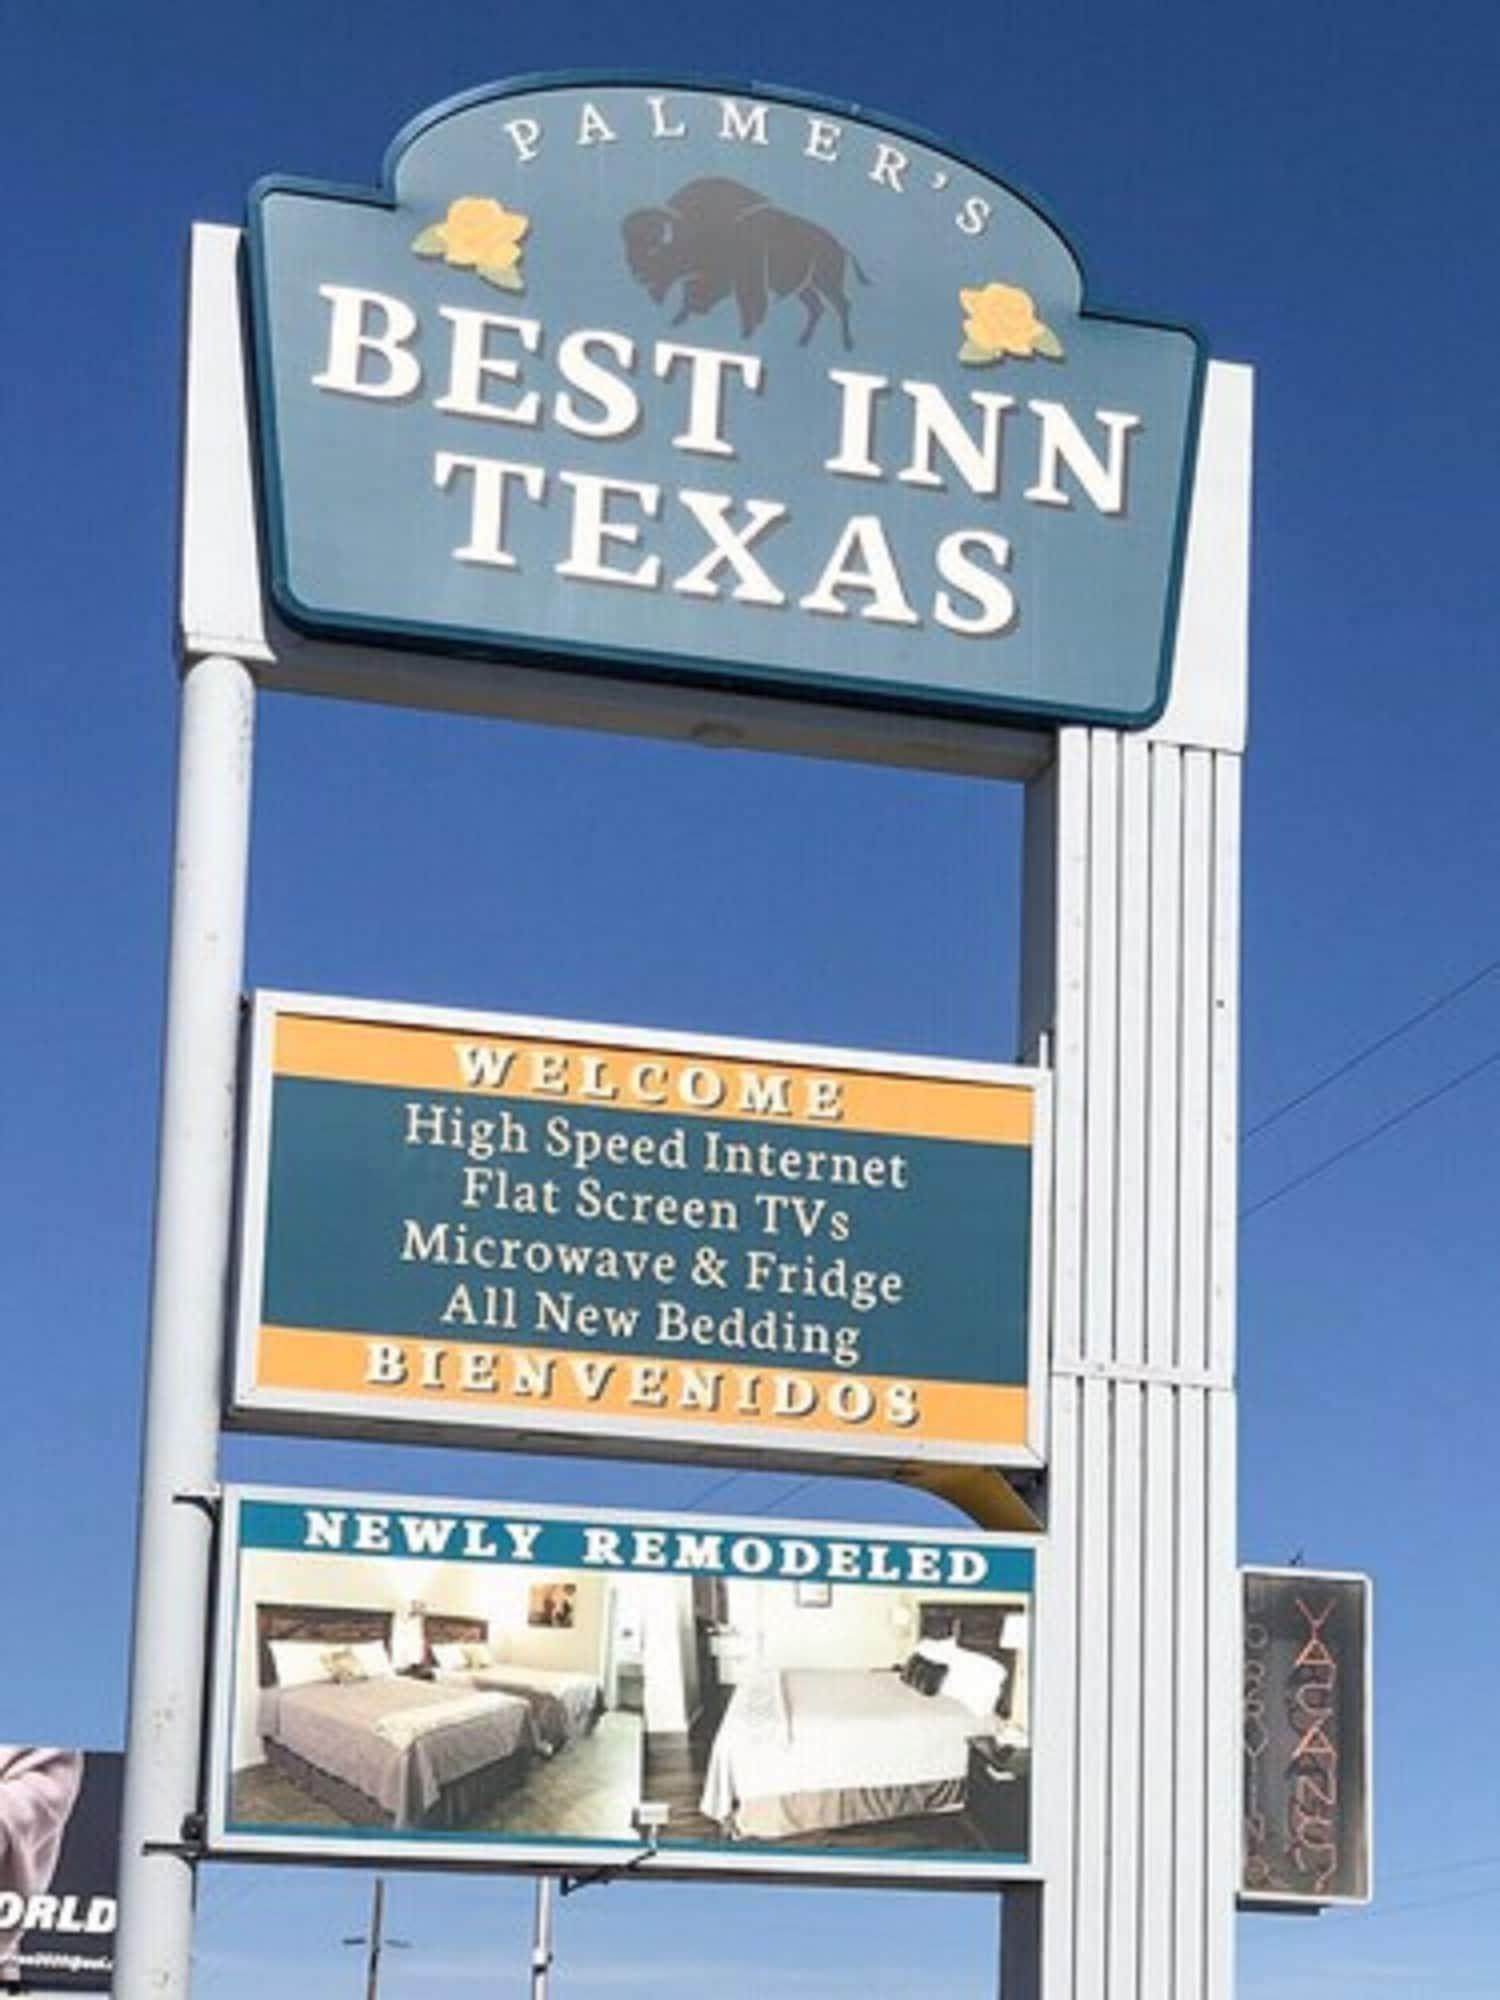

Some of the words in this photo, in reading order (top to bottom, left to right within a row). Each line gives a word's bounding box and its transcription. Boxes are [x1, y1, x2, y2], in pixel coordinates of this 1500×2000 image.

[503, 96, 993, 240] PALMER'S
[310, 284, 762, 458] BEST
[825, 368, 1140, 516] INN
[434, 450, 1018, 636] TEXAS
[455, 1042, 848, 1121] WELCOME
[403, 1102, 529, 1160] High
[545, 1118, 687, 1173] Speed
[704, 1131, 909, 1190] Internet
[462, 1167, 559, 1216] Flat
[575, 1180, 740, 1231] Screen
[755, 1195, 851, 1243] TVs
[401, 1220, 677, 1284] Microwave
[690, 1248, 729, 1288] &
[745, 1251, 905, 1307] Fridge
[440, 1284, 518, 1328] All
[534, 1291, 641, 1338] New
[656, 1302, 862, 1365] Bedding
[364, 1340, 922, 1428] BIENVENIDOS
[303, 1509, 543, 1561] NEWLY
[583, 1526, 990, 1587] REMODELED
